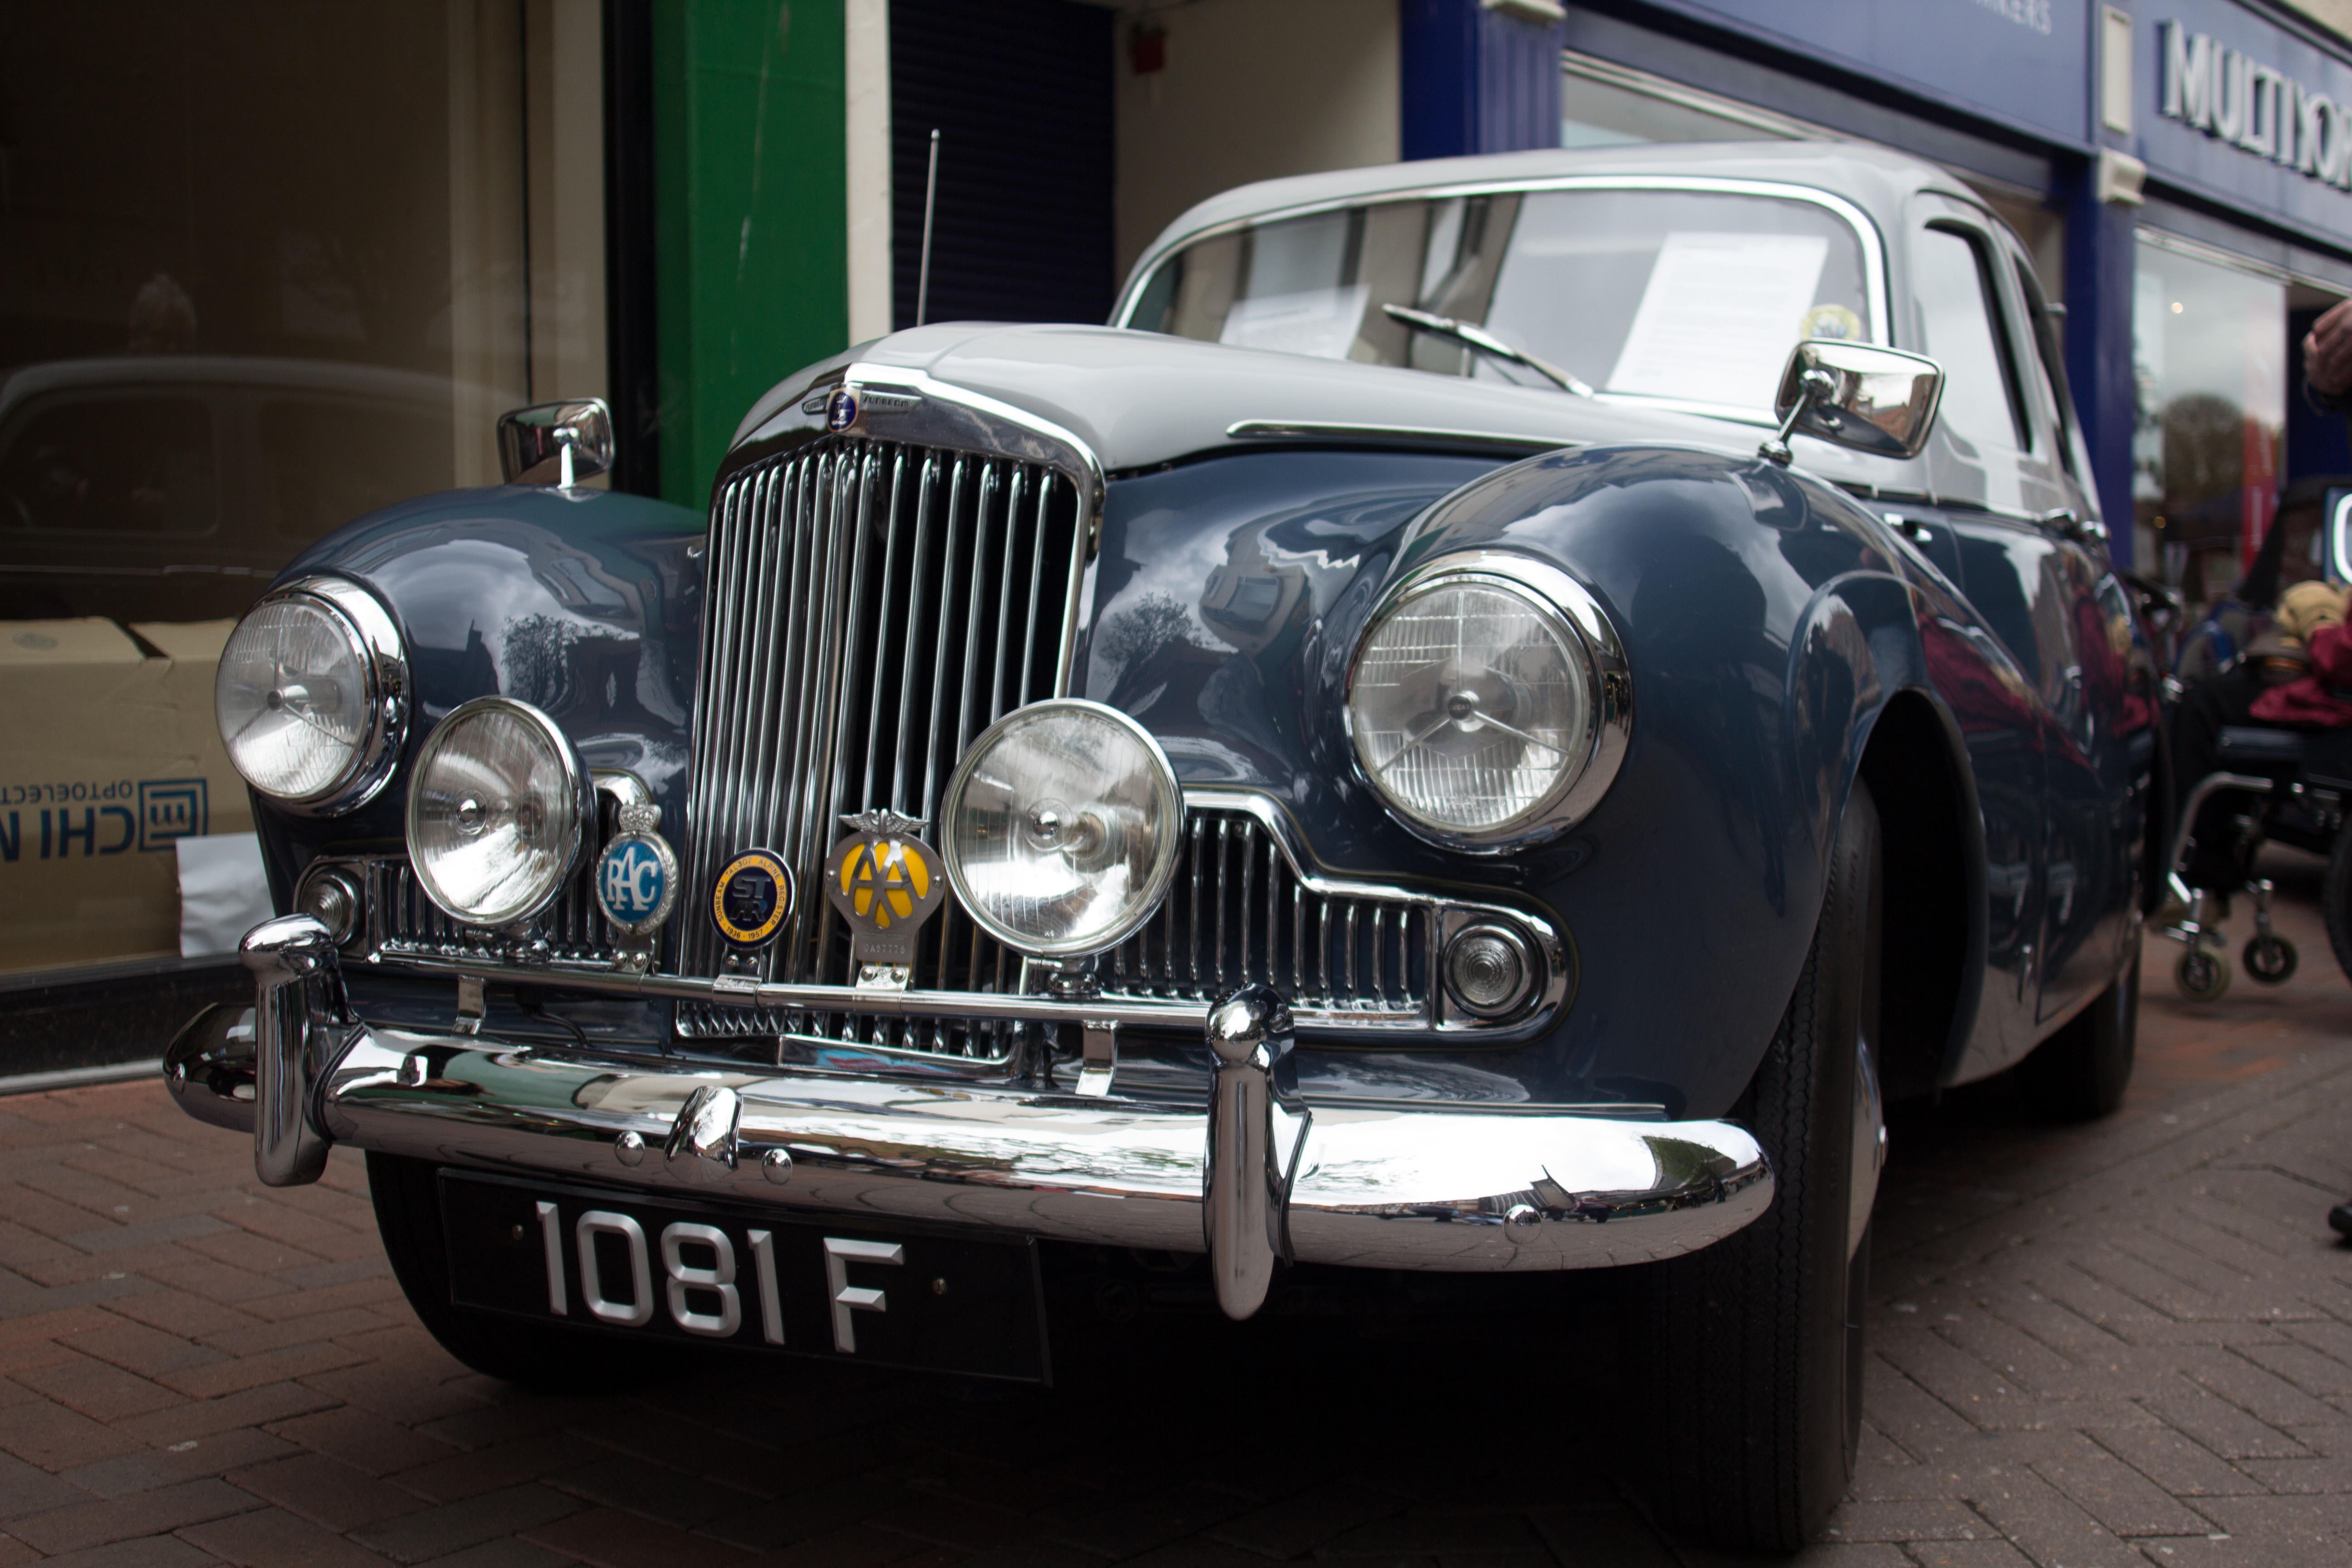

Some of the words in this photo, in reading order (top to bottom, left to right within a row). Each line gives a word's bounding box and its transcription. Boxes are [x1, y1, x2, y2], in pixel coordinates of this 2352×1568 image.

[862, 394, 909, 408] SUNBEAM
[607, 847, 657, 911] RAC
[715, 882, 725, 921] SUNBEAM
[725, 858, 751, 877] TALBOT
[758, 858, 781, 879] ALPINE
[770, 885, 785, 926] REGISTER
[733, 876, 771, 898] ST
[845, 840, 923, 923] AA
[726, 926, 741, 938] 1936
[749, 929, 763, 939] 1957
[536, 1200, 786, 1345] 1081
[823, 1237, 904, 1354] F
